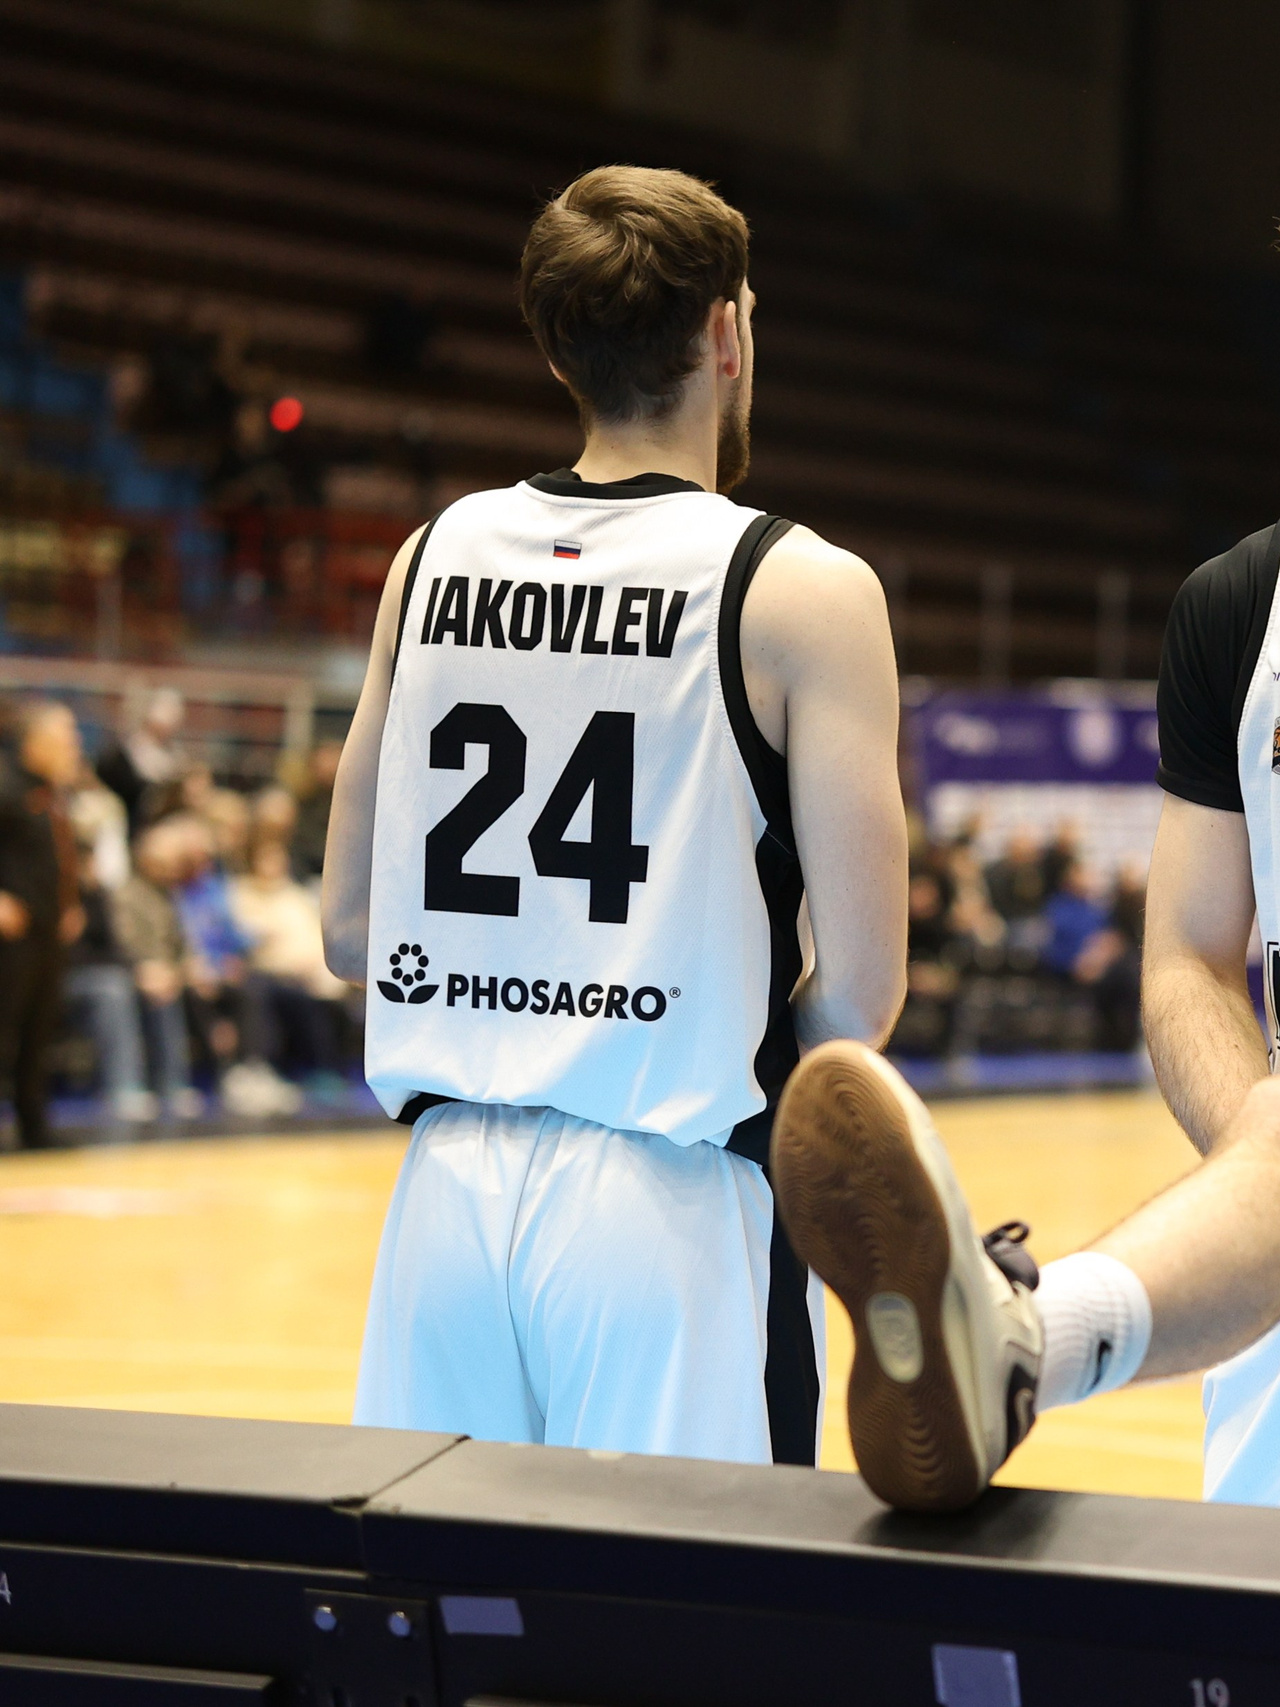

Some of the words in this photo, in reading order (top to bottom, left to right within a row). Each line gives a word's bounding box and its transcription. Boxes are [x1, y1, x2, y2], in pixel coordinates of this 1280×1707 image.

[420, 576, 688, 658] IAKOVLEV
[424, 702, 649, 924] 24
[1188, 1678, 1230, 1707] 19
